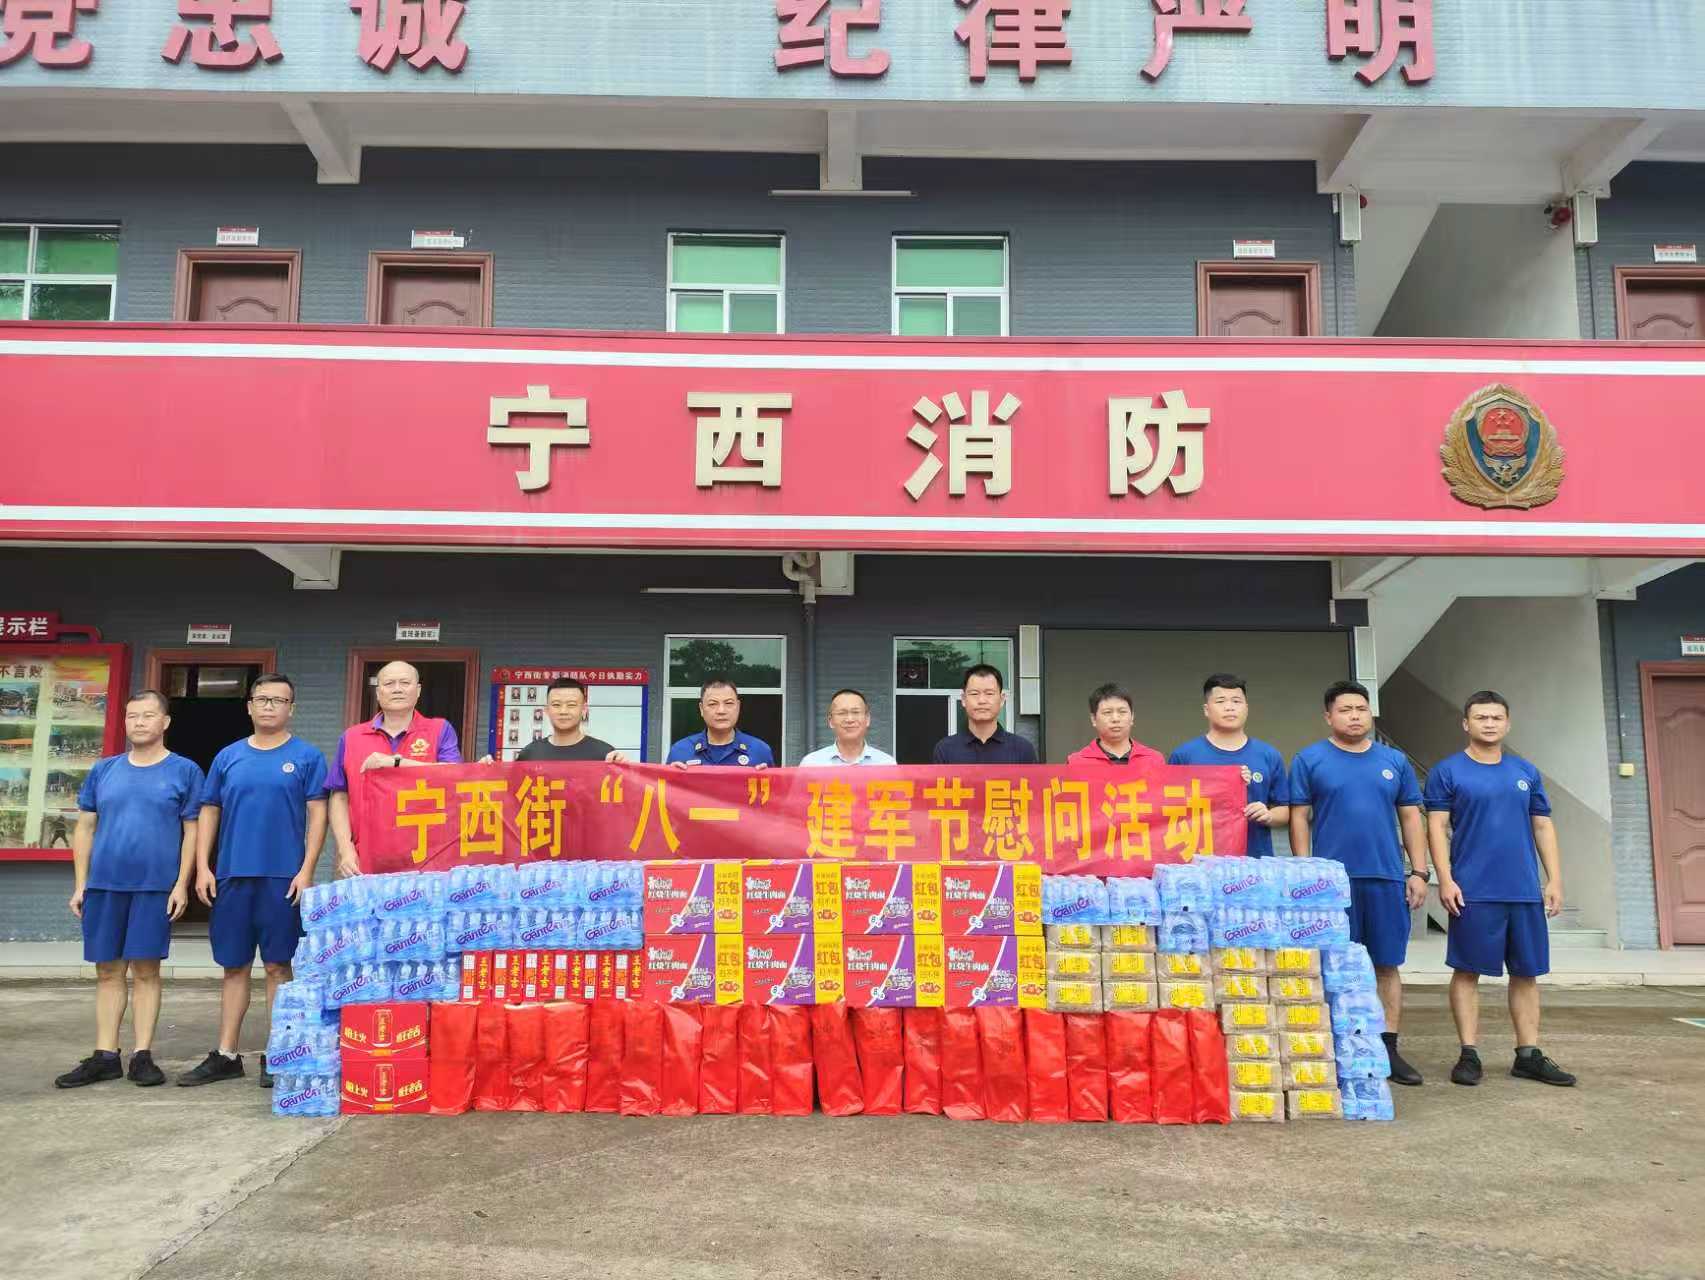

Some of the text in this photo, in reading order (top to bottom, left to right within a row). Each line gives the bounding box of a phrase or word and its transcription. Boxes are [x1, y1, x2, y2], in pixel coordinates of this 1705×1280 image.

[487, 385, 1211, 501] 宁西消防
[0, 617, 48, 636] 示栏
